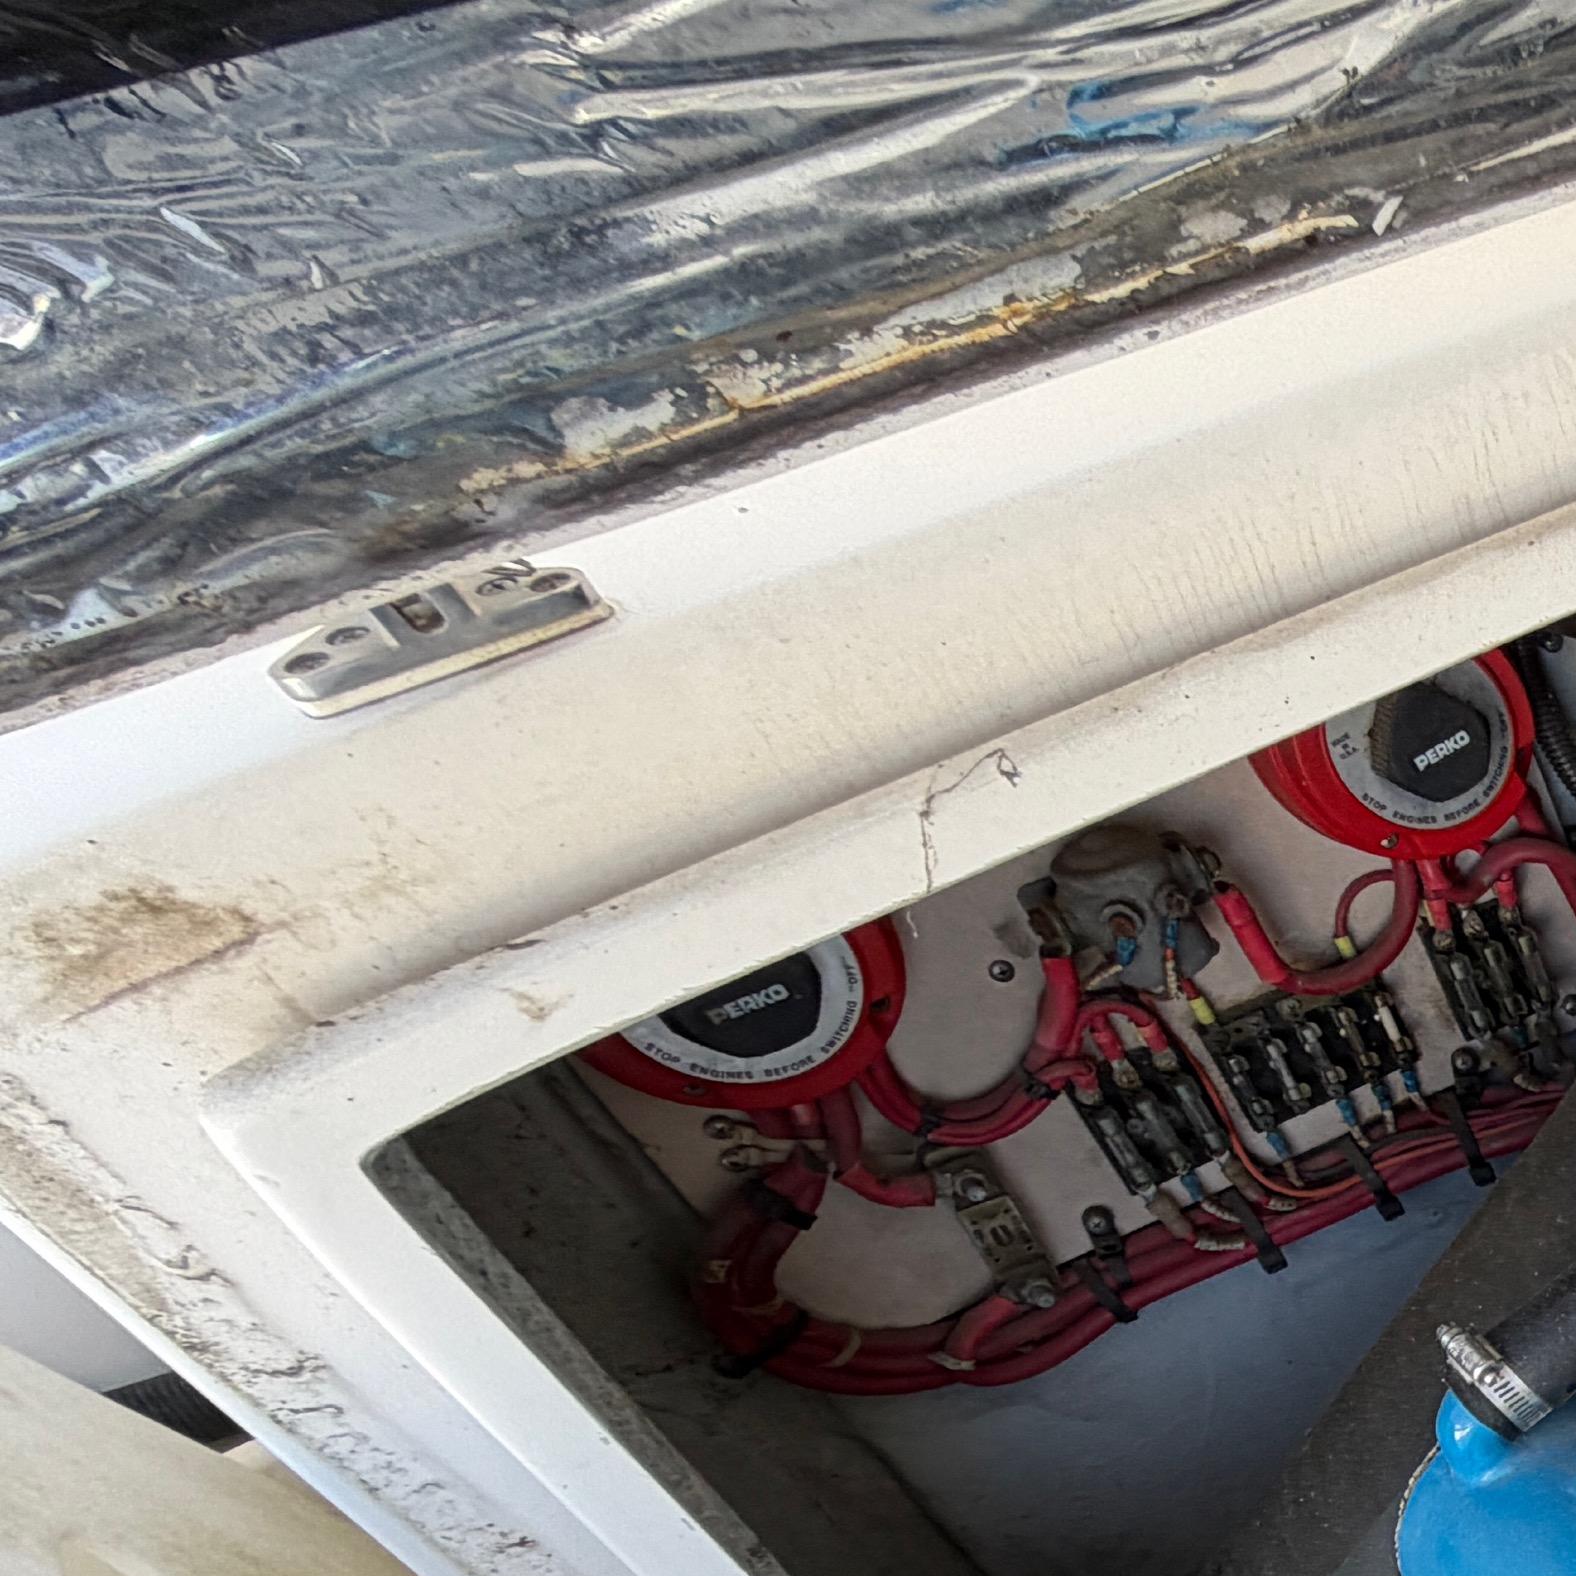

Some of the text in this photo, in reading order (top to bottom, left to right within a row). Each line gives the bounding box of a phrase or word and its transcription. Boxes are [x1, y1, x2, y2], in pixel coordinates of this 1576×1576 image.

[1361, 745, 1509, 825] STOP ENGINES BEFORE SWITCHING
[1413, 729, 1471, 773] PERKO
[643, 1041, 682, 1065] STOP
[689, 1062, 755, 1080] ENGINES
[764, 1054, 817, 1078] BEFORE
[821, 1000, 859, 1055] SWITCHING
